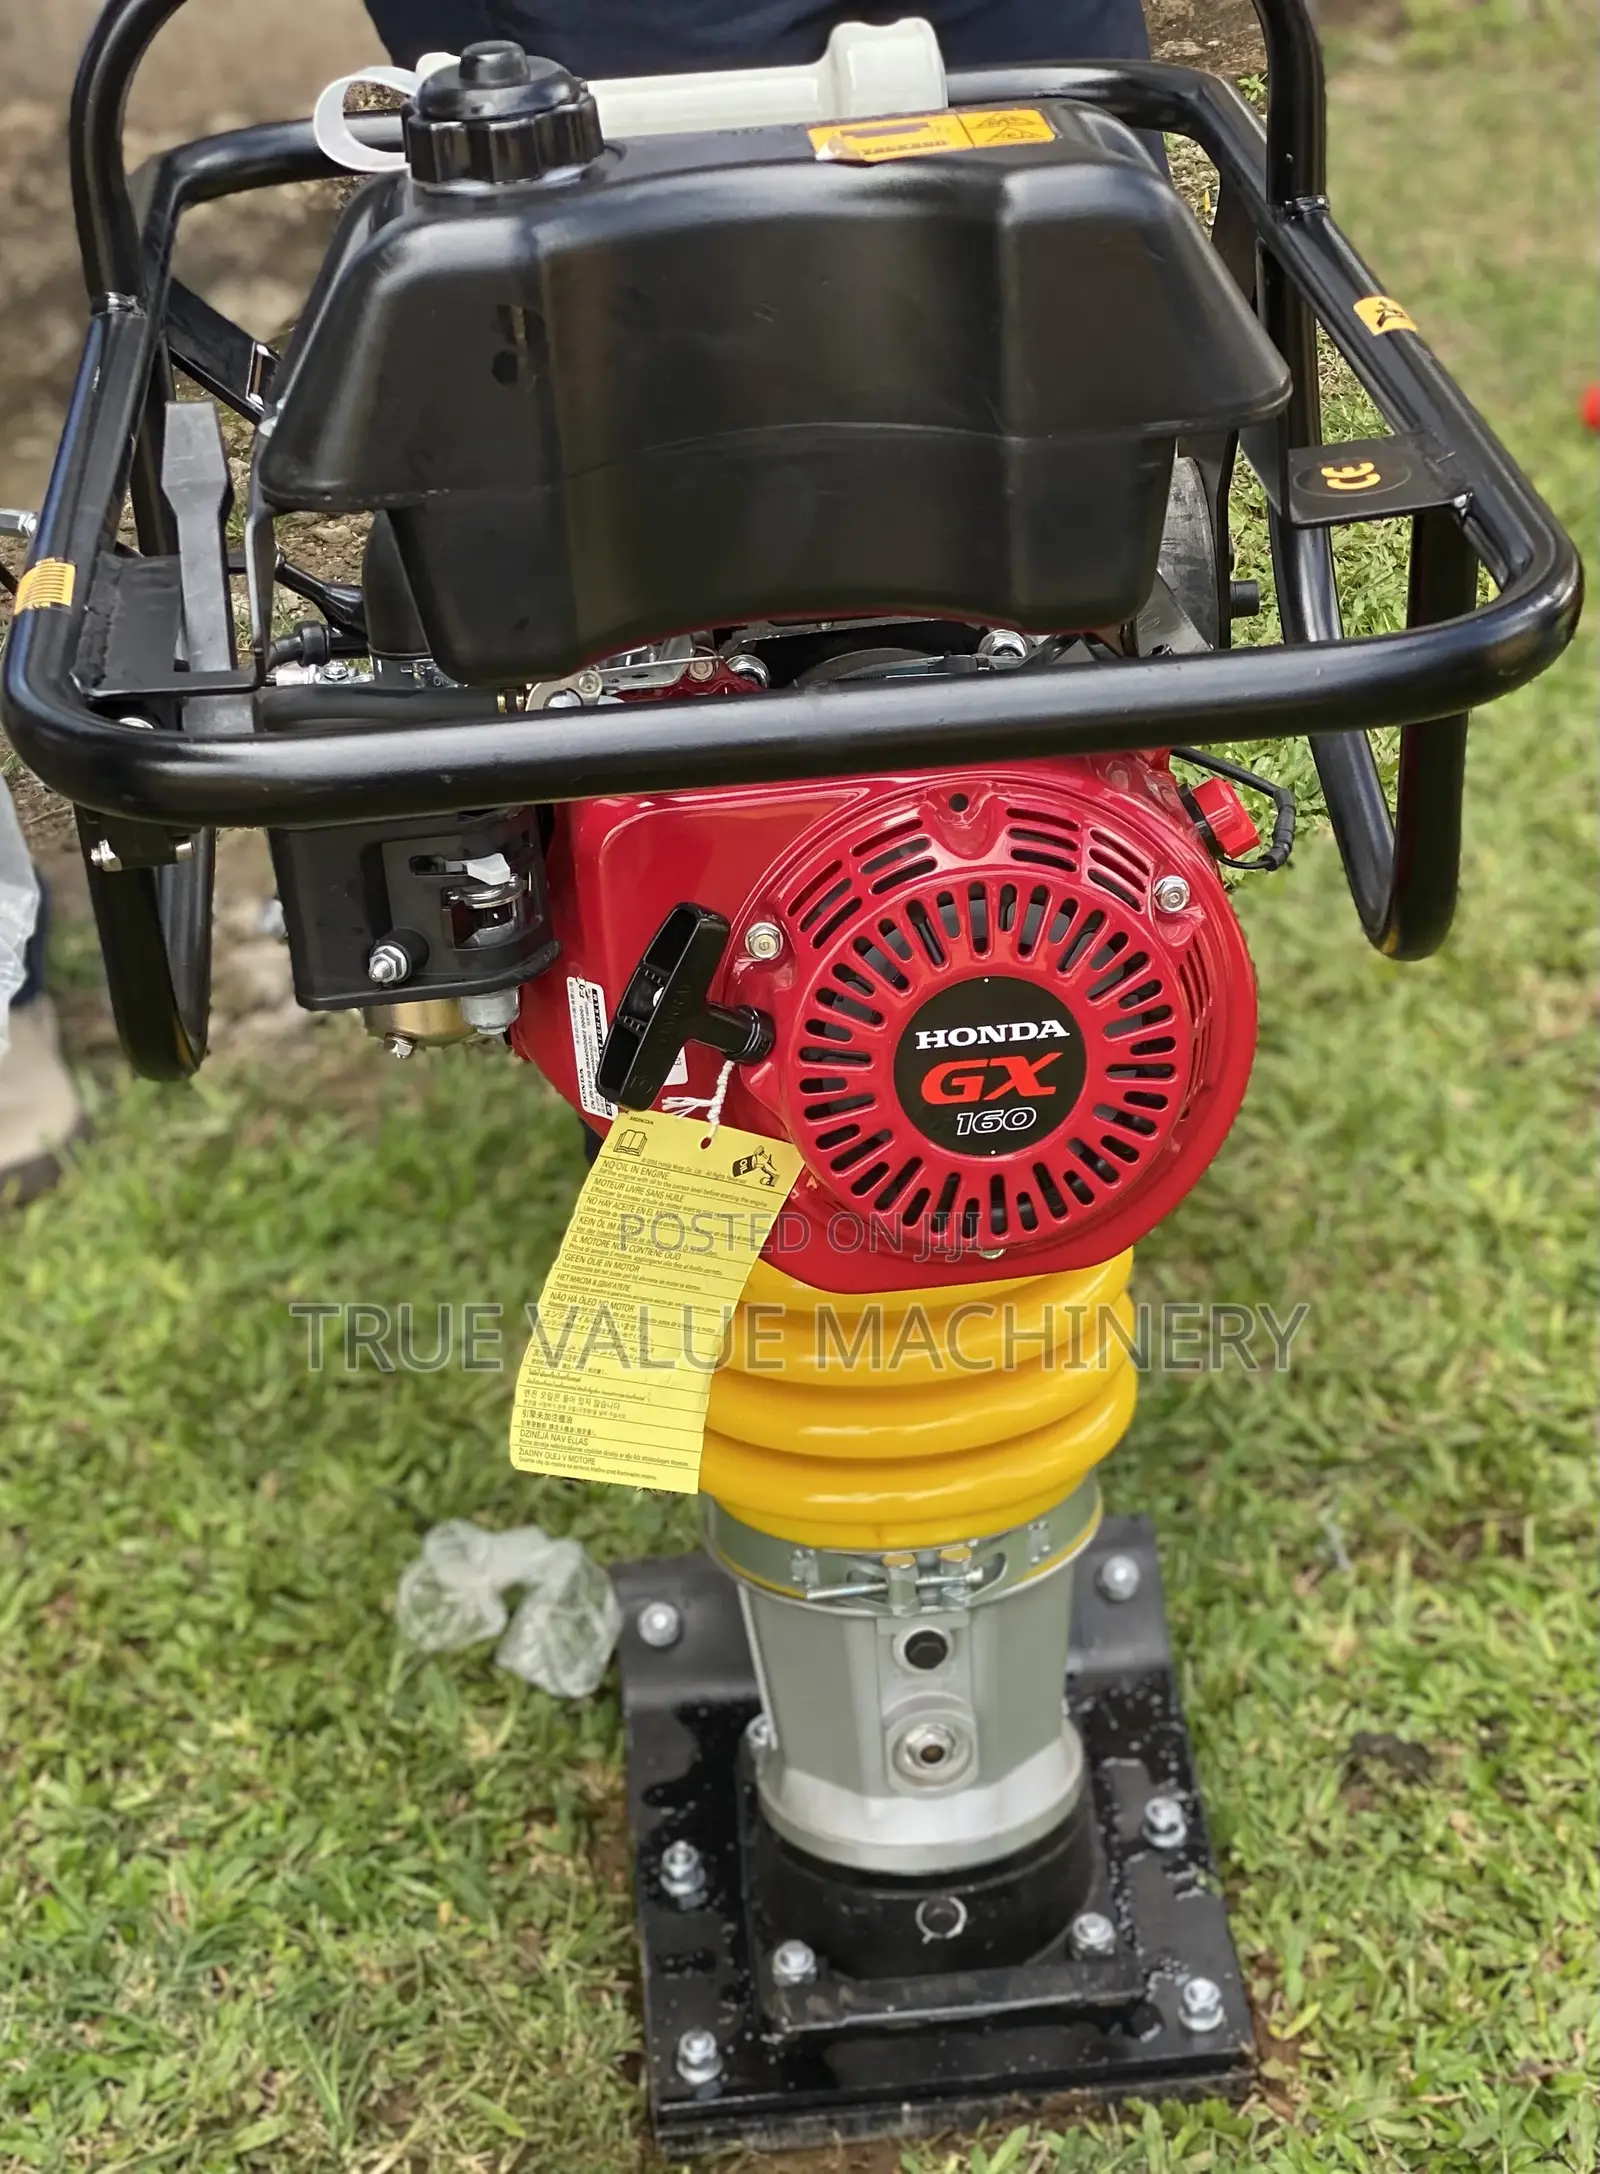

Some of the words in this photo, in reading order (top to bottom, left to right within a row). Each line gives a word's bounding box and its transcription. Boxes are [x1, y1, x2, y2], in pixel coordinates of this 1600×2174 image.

[915, 1019, 1070, 1050] HONDA
[579, 1068, 587, 1107] HONDA
[921, 1052, 1063, 1105] GX
[630, 1116, 653, 1125] HONDA
[956, 1106, 1037, 1136] 160
[602, 1159, 615, 1169] NO
[616, 1162, 628, 1172] OIL
[630, 1165, 639, 1174] IN
[640, 1167, 670, 1180] ENGINE
[740, 1158, 749, 1175] OIL
[593, 1177, 625, 1191] MOTEUR
[625, 1184, 645, 1195] LIVRE
[645, 1188, 665, 1199] SANS
[664, 1192, 684, 1203] HUILE
[703, 1189, 720, 1197] before
[720, 1193, 740, 1202] starting
[586, 1196, 598, 1205] NO
[598, 1197, 613, 1208] HAY
[612, 1199, 636, 1212] ACEITE
[636, 1204, 646, 1214] EN
[645, 1206, 655, 1216] EL
[579, 1216, 596, 1226] KEIN
[596, 1218, 605, 1228] ÖL
[606, 1221, 617, 1230] IM
[616, 1223, 642, 1234] MOTOR
[571, 1234, 578, 1242] IL
[580, 1236, 611, 1248] MOTORE
[611, 1241, 628, 1251] NON
[629, 1245, 663, 1257] CONTIENE
[664, 1251, 681, 1261] OLIO
[564, 1253, 586, 1263] GEEN
[586, 1257, 603, 1266] OLIE
[604, 1260, 613, 1268] IN
[613, 1262, 640, 1273] MOTOR
[556, 1272, 570, 1281] НЕТ
[550, 1291, 567, 1301] NÃO
[567, 1294, 578, 1303] HÁ
[578, 1295, 597, 1306] ÓLEO
[609, 1302, 635, 1312] MOTOR
[550, 1433, 566, 1443] NAV
[544, 1451, 561, 1460] OLEJ
[568, 1455, 595, 1466] MOTORE
